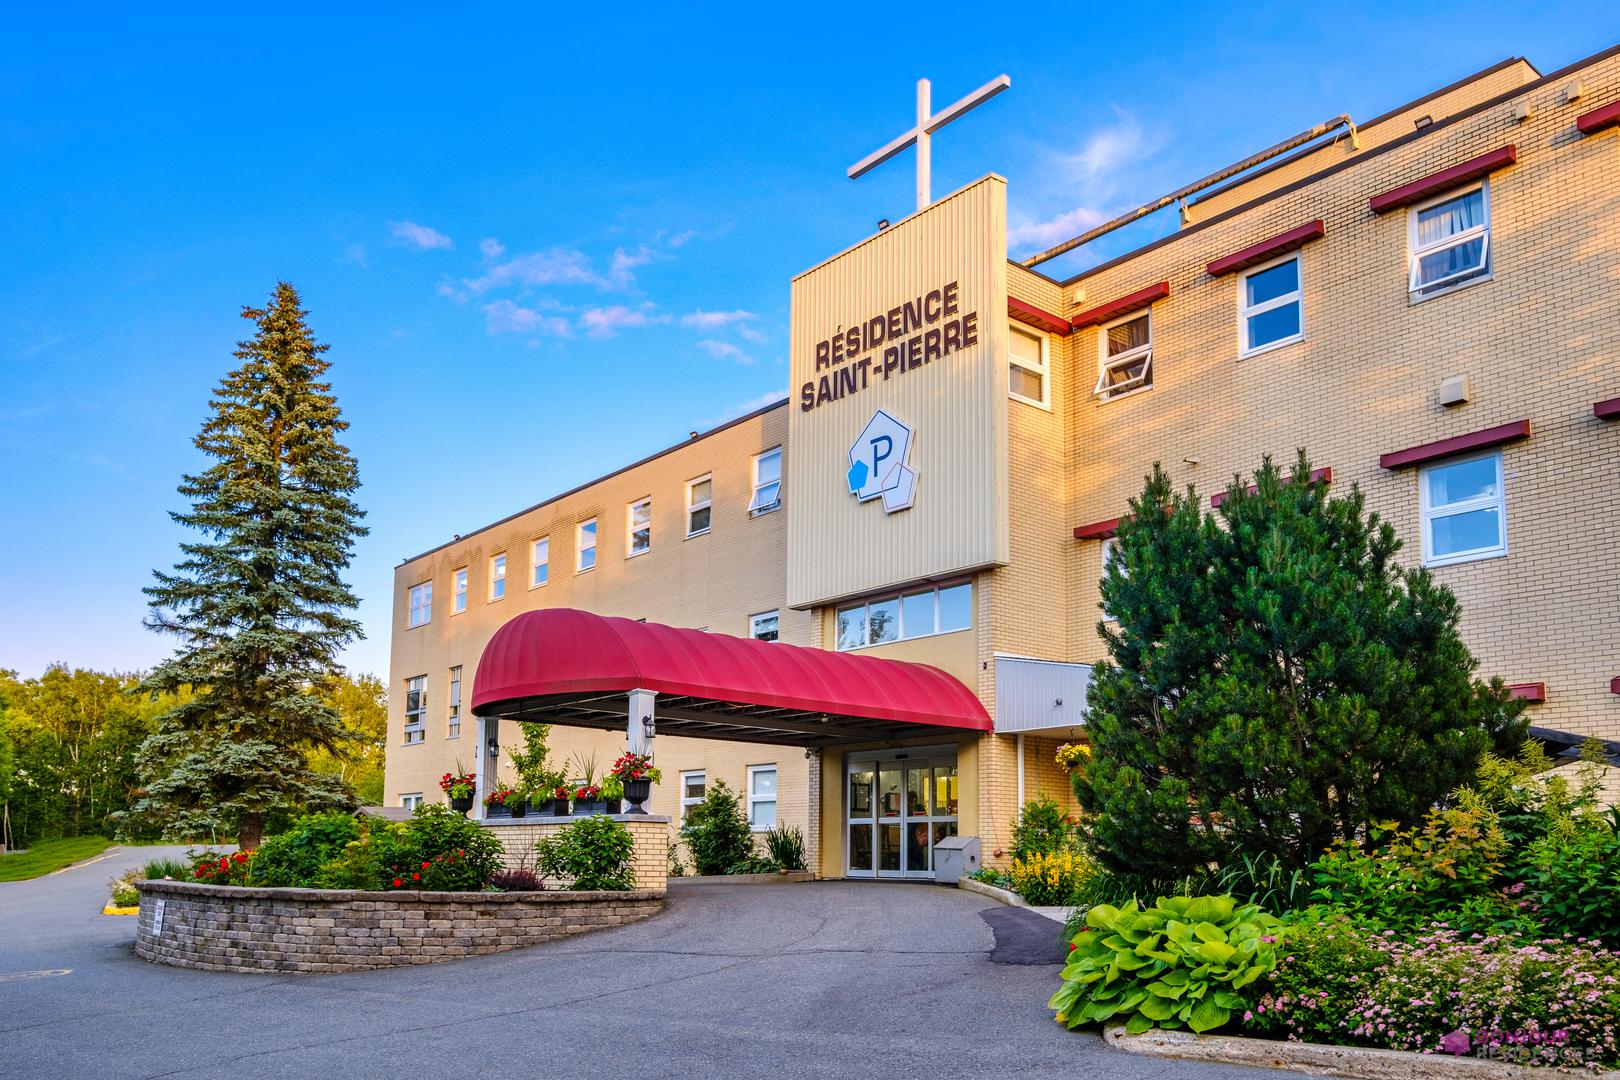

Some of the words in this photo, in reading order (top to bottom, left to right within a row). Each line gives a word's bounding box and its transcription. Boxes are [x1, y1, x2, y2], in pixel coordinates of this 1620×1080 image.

[800, 311, 979, 412] SAINT-PIERRE
[815, 280, 959, 373] RÉSIDENCE
[870, 434, 893, 478] P
